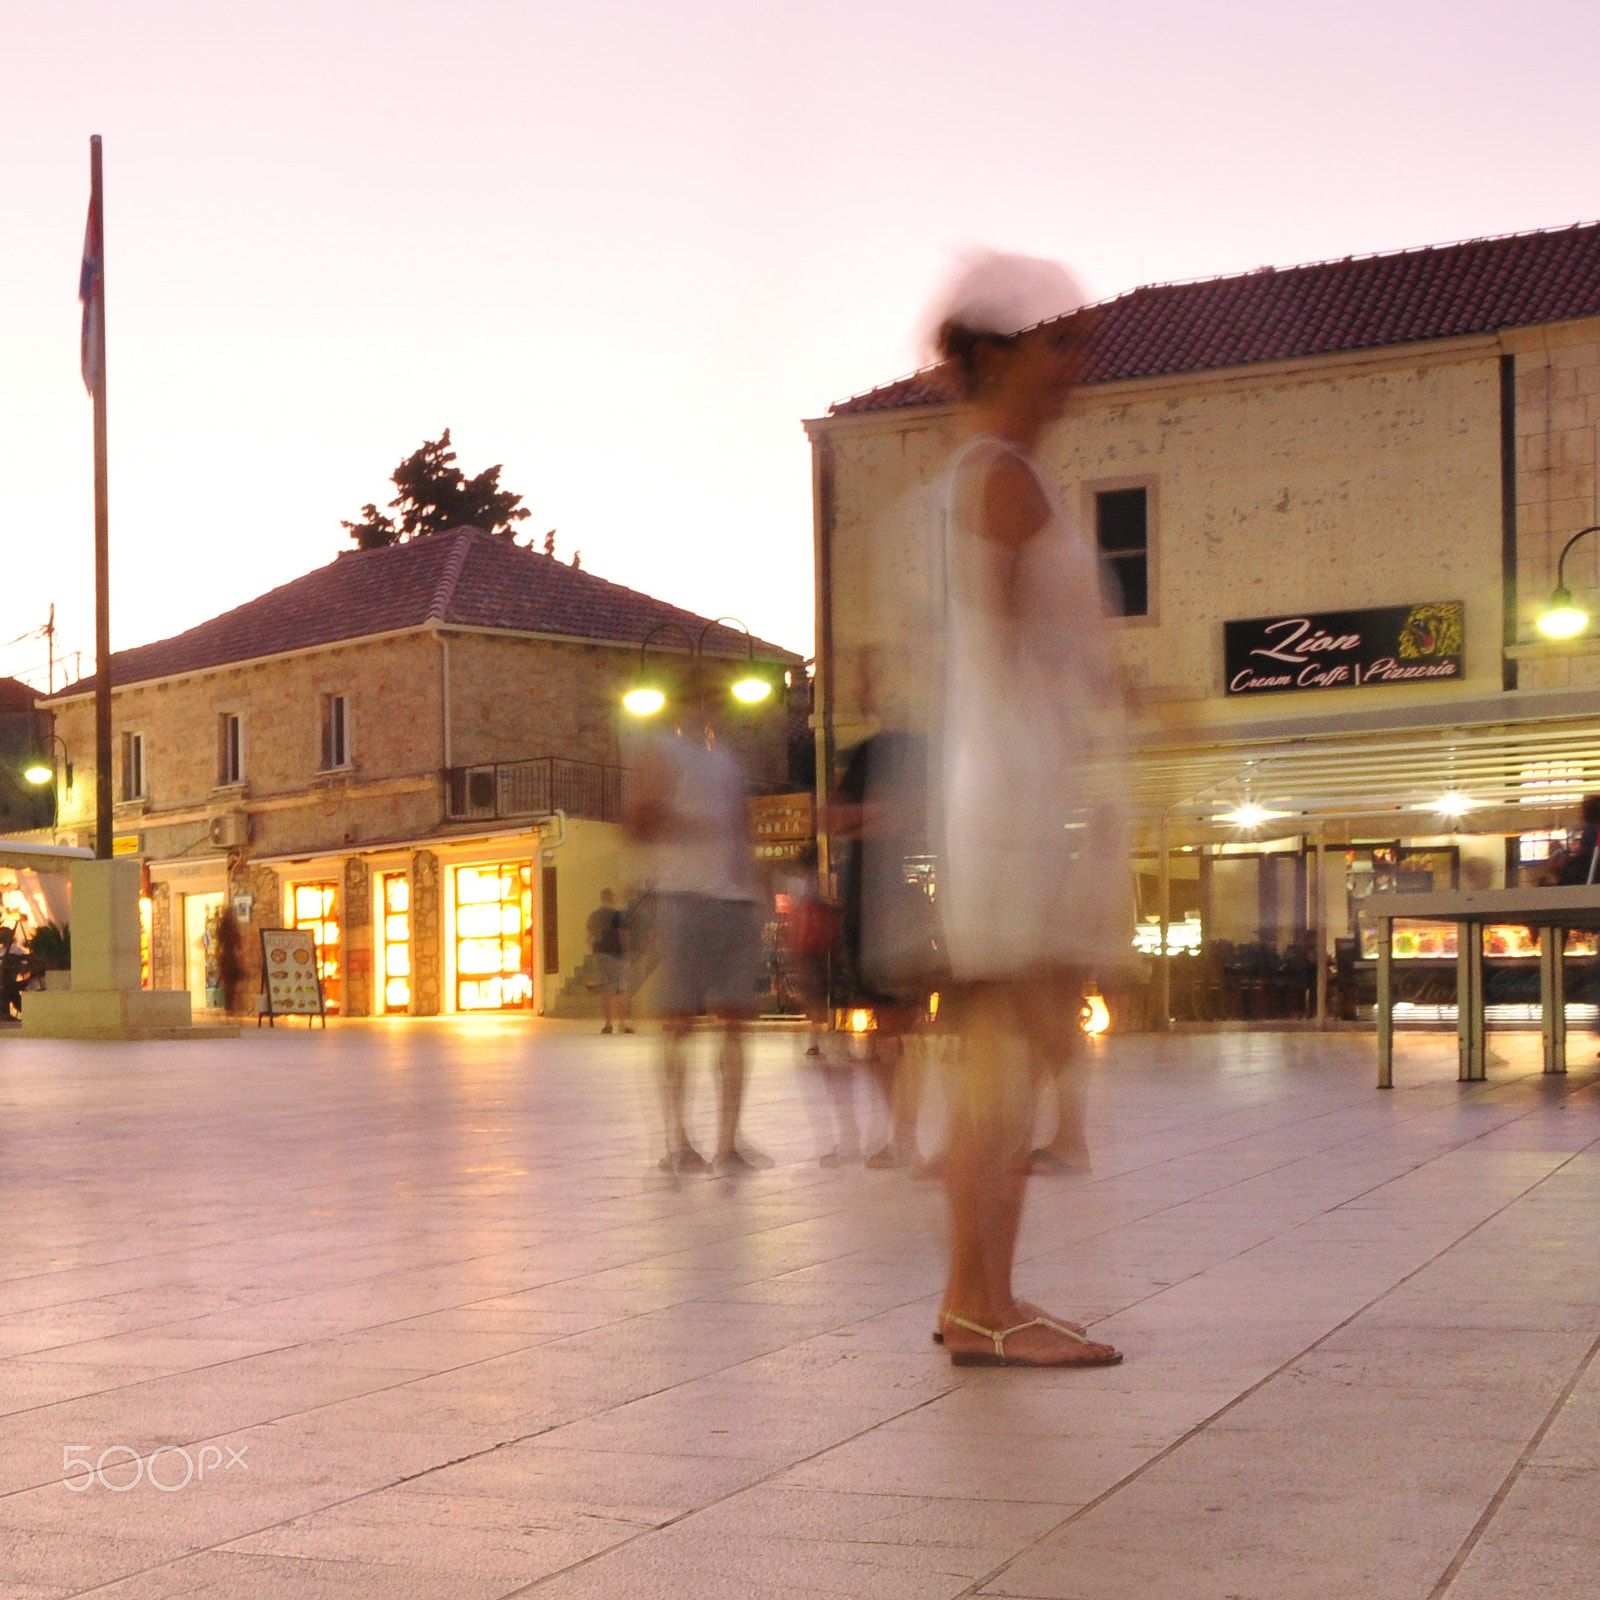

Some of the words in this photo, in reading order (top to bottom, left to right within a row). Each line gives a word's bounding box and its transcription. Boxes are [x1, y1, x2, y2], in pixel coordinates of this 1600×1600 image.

[1250, 618, 1361, 662] Zion
[1230, 669, 1291, 692] Cream
[1363, 658, 1456, 682] Pizzeria
